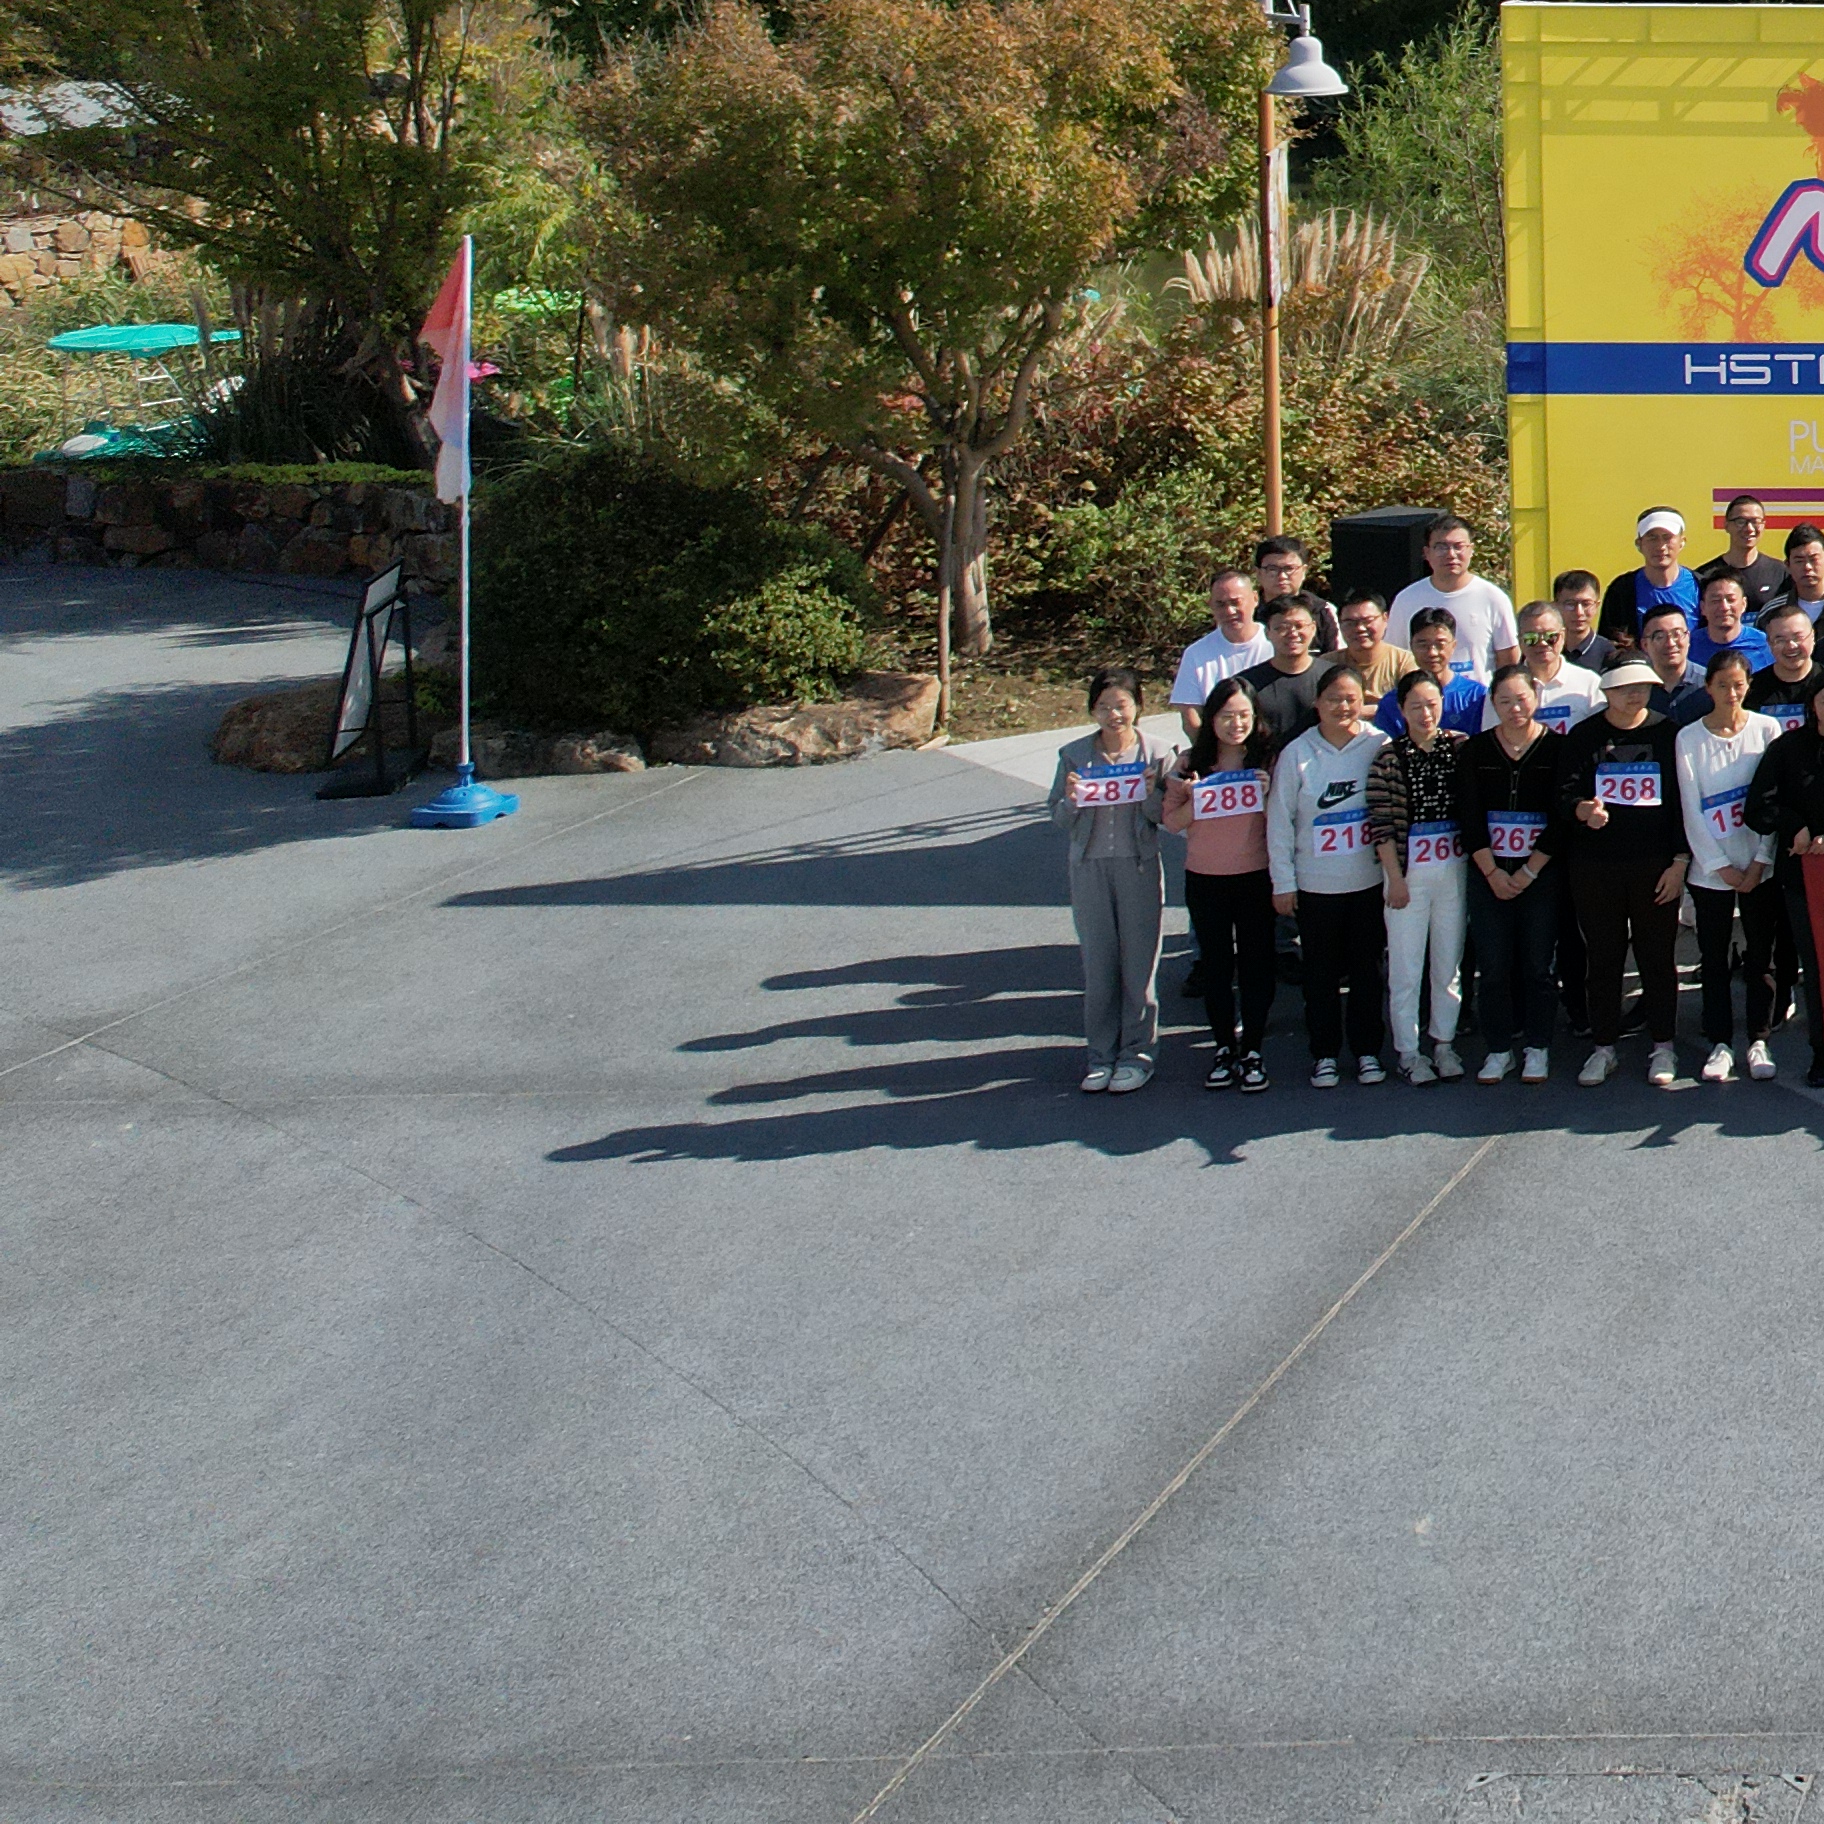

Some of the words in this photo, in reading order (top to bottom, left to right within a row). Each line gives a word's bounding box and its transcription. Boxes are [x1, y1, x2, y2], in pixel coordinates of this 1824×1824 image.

[1083, 778, 1141, 802] 287
[1200, 785, 1258, 814] 288
[1325, 780, 1358, 797] NIKE
[1601, 777, 1657, 801] 268
[1321, 821, 1374, 852] 218
[1491, 826, 1544, 853] 265
